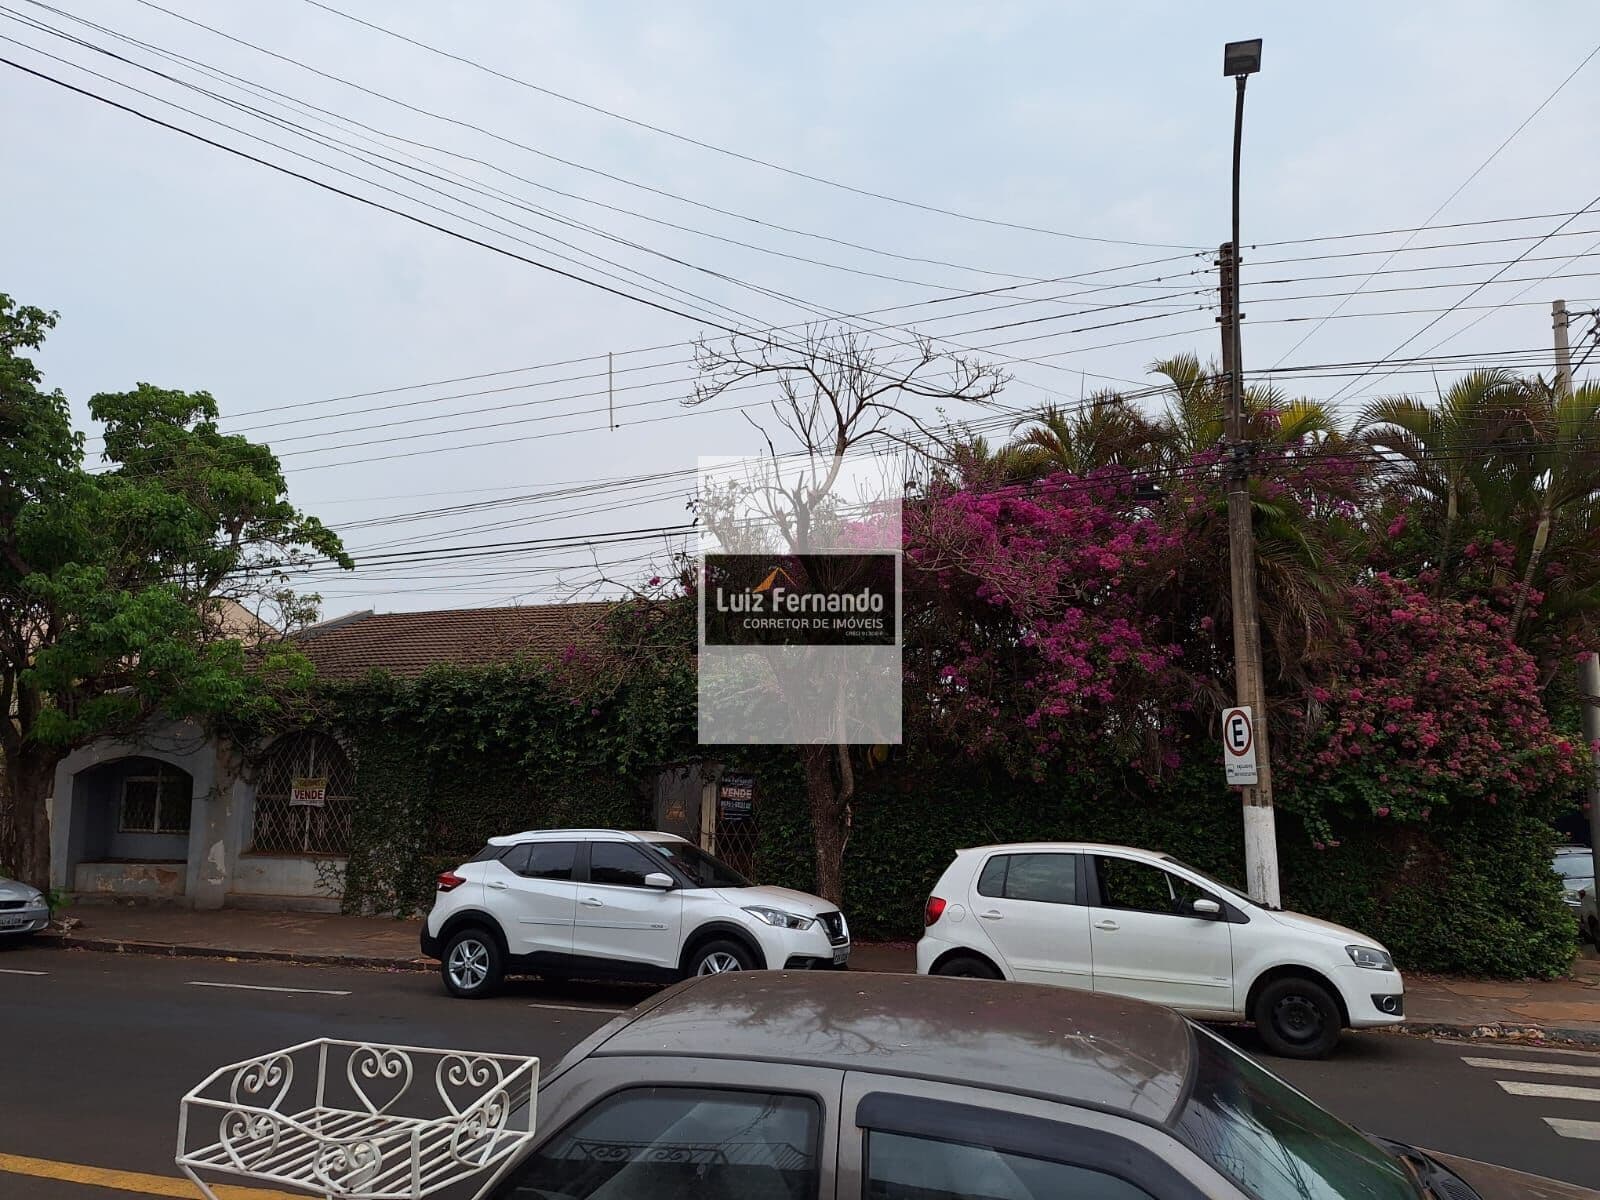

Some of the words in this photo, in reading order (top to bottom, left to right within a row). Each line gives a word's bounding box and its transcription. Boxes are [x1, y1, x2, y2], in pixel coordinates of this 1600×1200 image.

[1232, 718, 1244, 748] E
[294, 790, 324, 800] VENDE
[722, 787, 752, 799] VENDE
